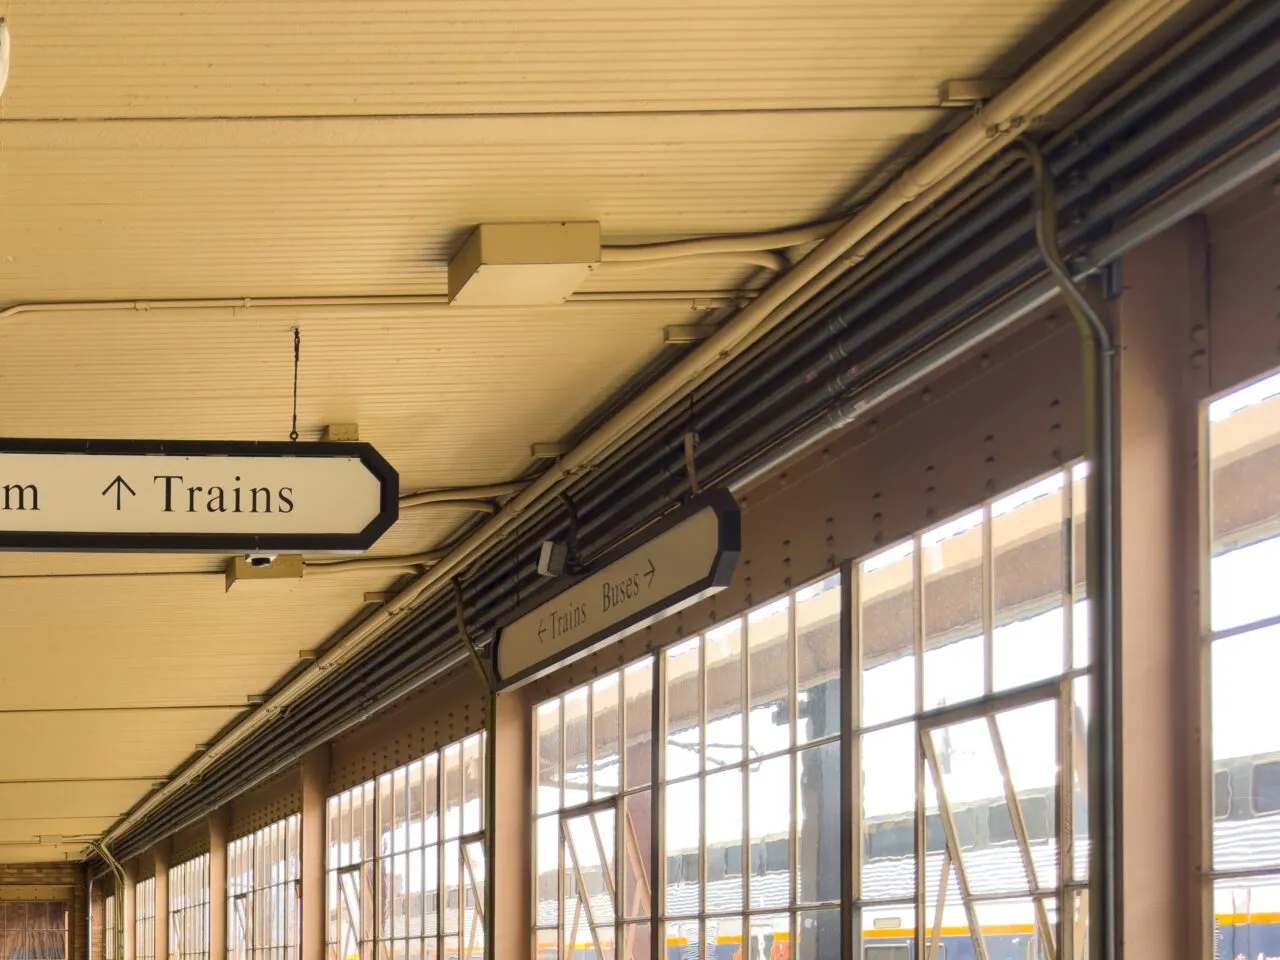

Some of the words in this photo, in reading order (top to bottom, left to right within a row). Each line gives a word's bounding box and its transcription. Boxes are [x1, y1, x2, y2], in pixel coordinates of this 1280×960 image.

[153, 475, 295, 514] Trains
[550, 601, 587, 640] Trains
[602, 573, 640, 613] Buses
